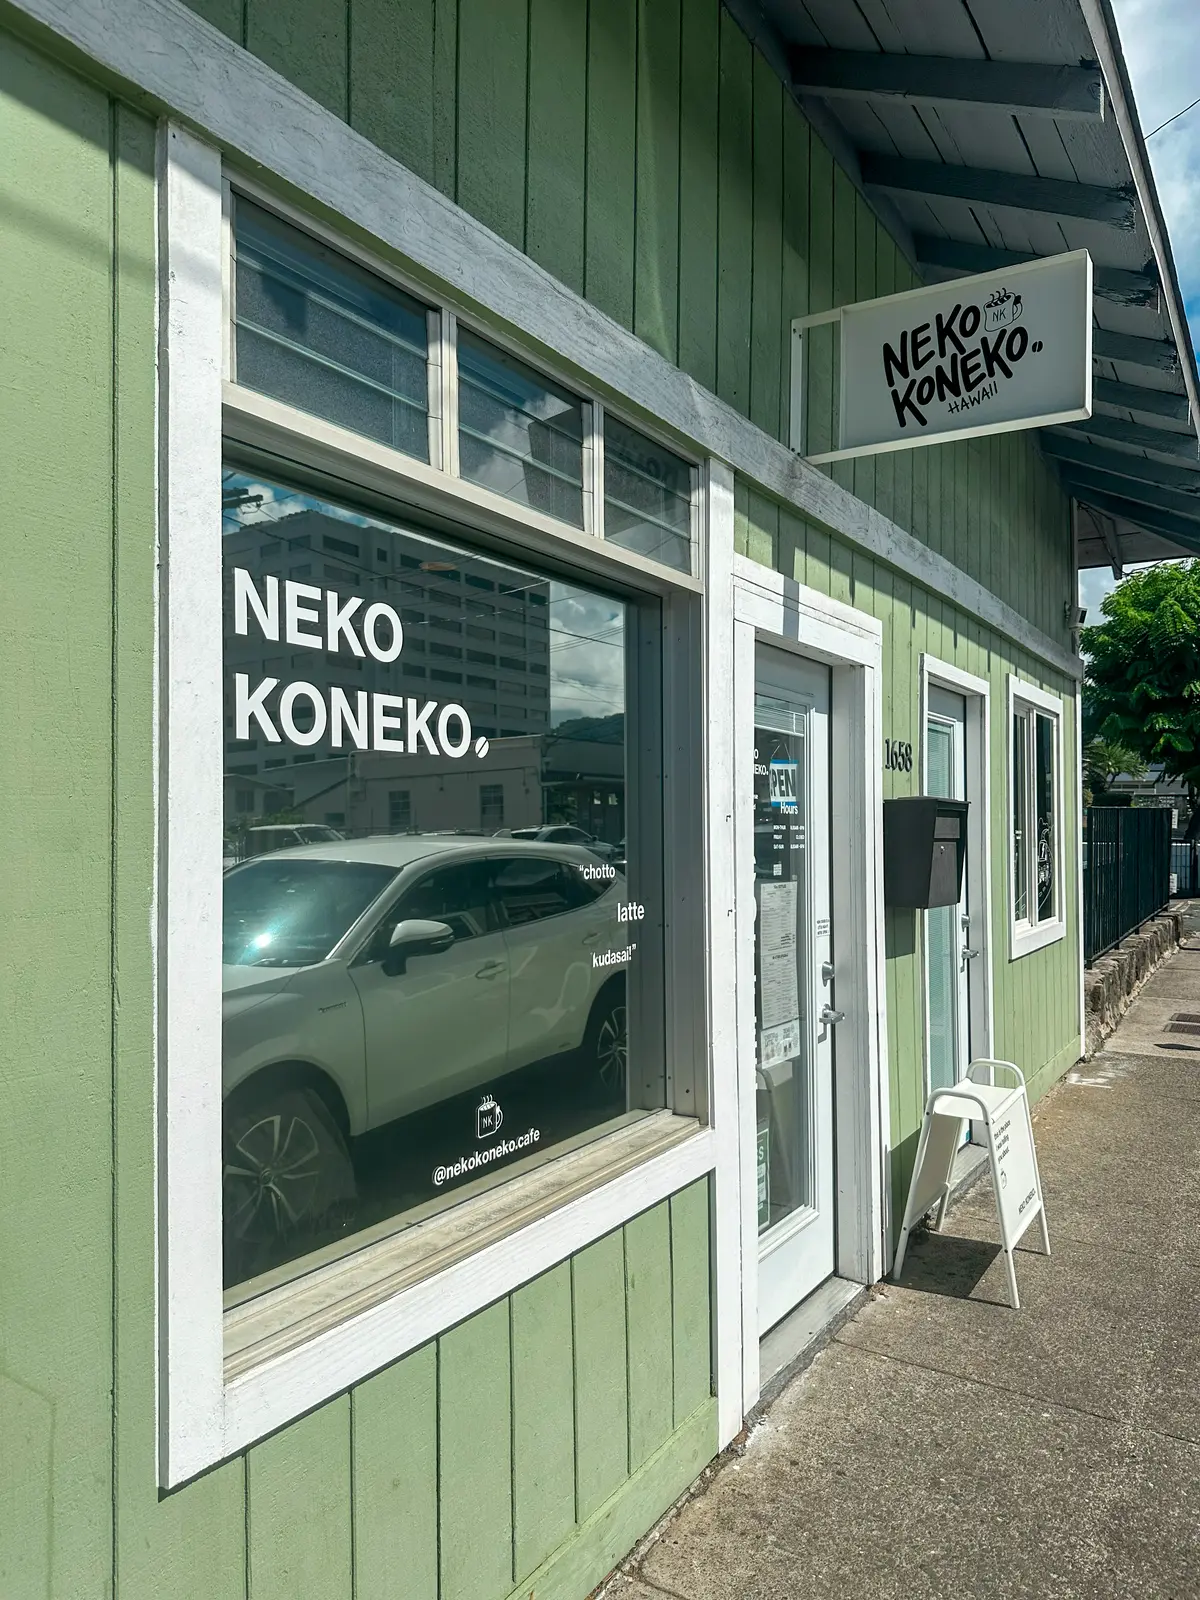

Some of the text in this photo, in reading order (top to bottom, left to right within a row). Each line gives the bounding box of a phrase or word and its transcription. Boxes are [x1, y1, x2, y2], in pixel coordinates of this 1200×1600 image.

[992, 307, 1007, 322] NK
[883, 303, 981, 387] NEKO
[948, 380, 999, 414] HAWAII
[234, 566, 403, 663] NEKO
[885, 738, 913, 773] 1658
[770, 768, 796, 797] PEN
[780, 801, 798, 815] Hours
[579, 864, 616, 880] “chotto
[617, 902, 645, 922] latte
[592, 943, 637, 968] kudasai!”
[482, 1115, 493, 1128] NK
[433, 1127, 541, 1186] @nekokoneko.cafe
